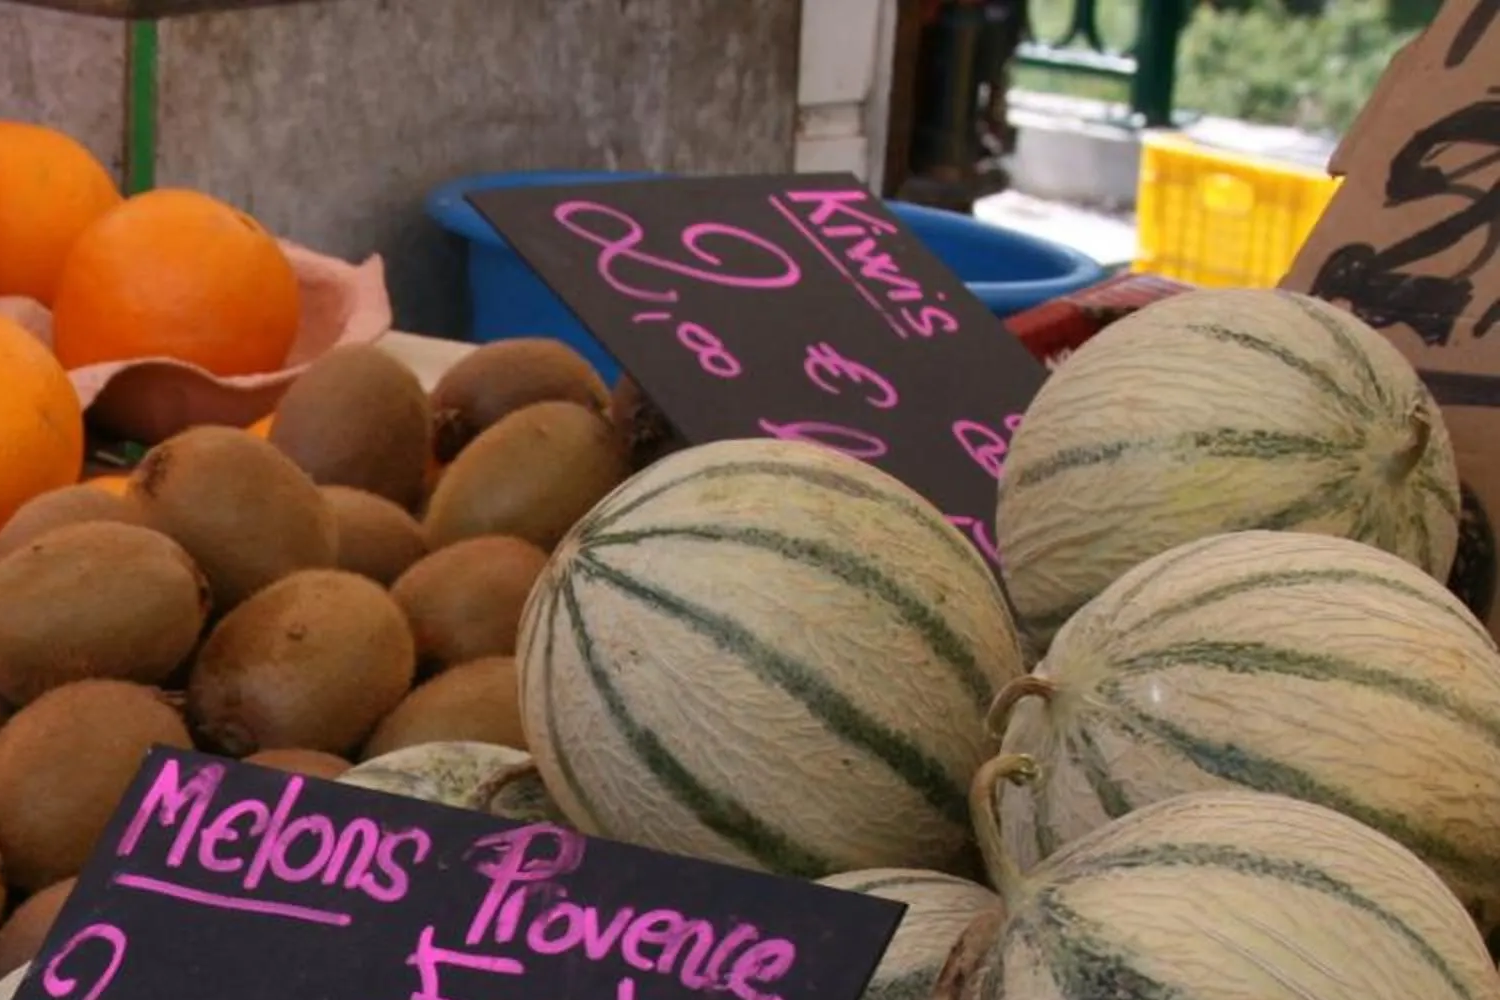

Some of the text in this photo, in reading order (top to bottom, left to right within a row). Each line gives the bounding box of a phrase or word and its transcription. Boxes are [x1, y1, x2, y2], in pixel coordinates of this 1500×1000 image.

[784, 190, 958, 338] Kiwis
[803, 341, 898, 408] €
[116, 758, 432, 902] Melons
